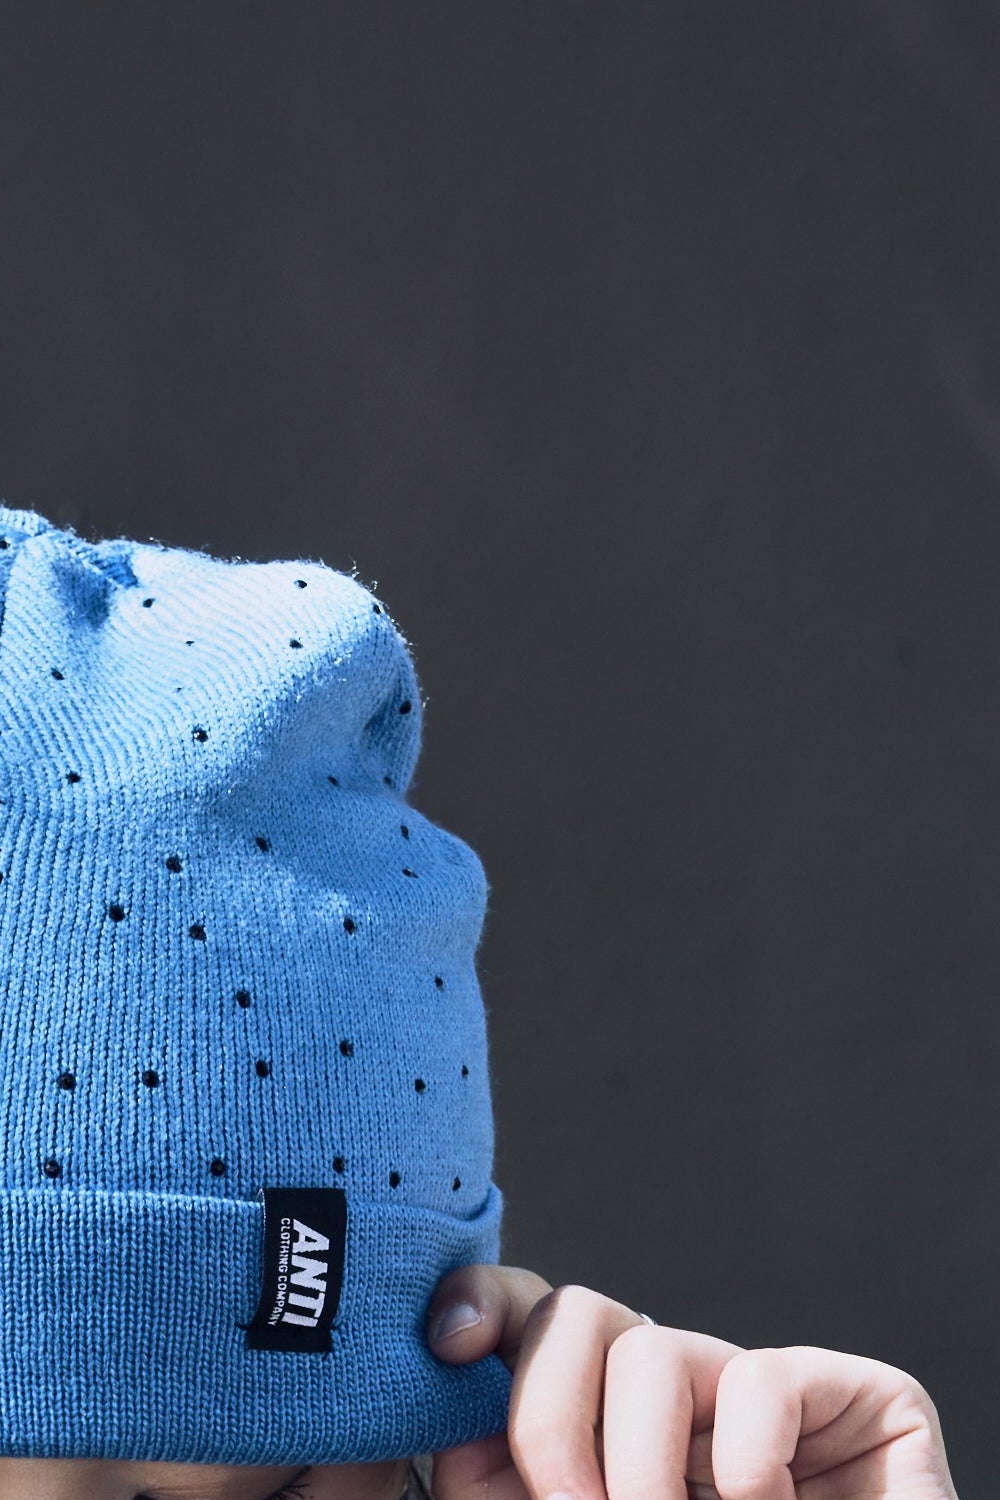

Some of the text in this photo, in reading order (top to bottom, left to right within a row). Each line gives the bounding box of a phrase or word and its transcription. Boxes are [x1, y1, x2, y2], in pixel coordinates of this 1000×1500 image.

[267, 1217, 291, 1327] CLOTHING COMPANY
[281, 1218, 330, 1328] ANTI
